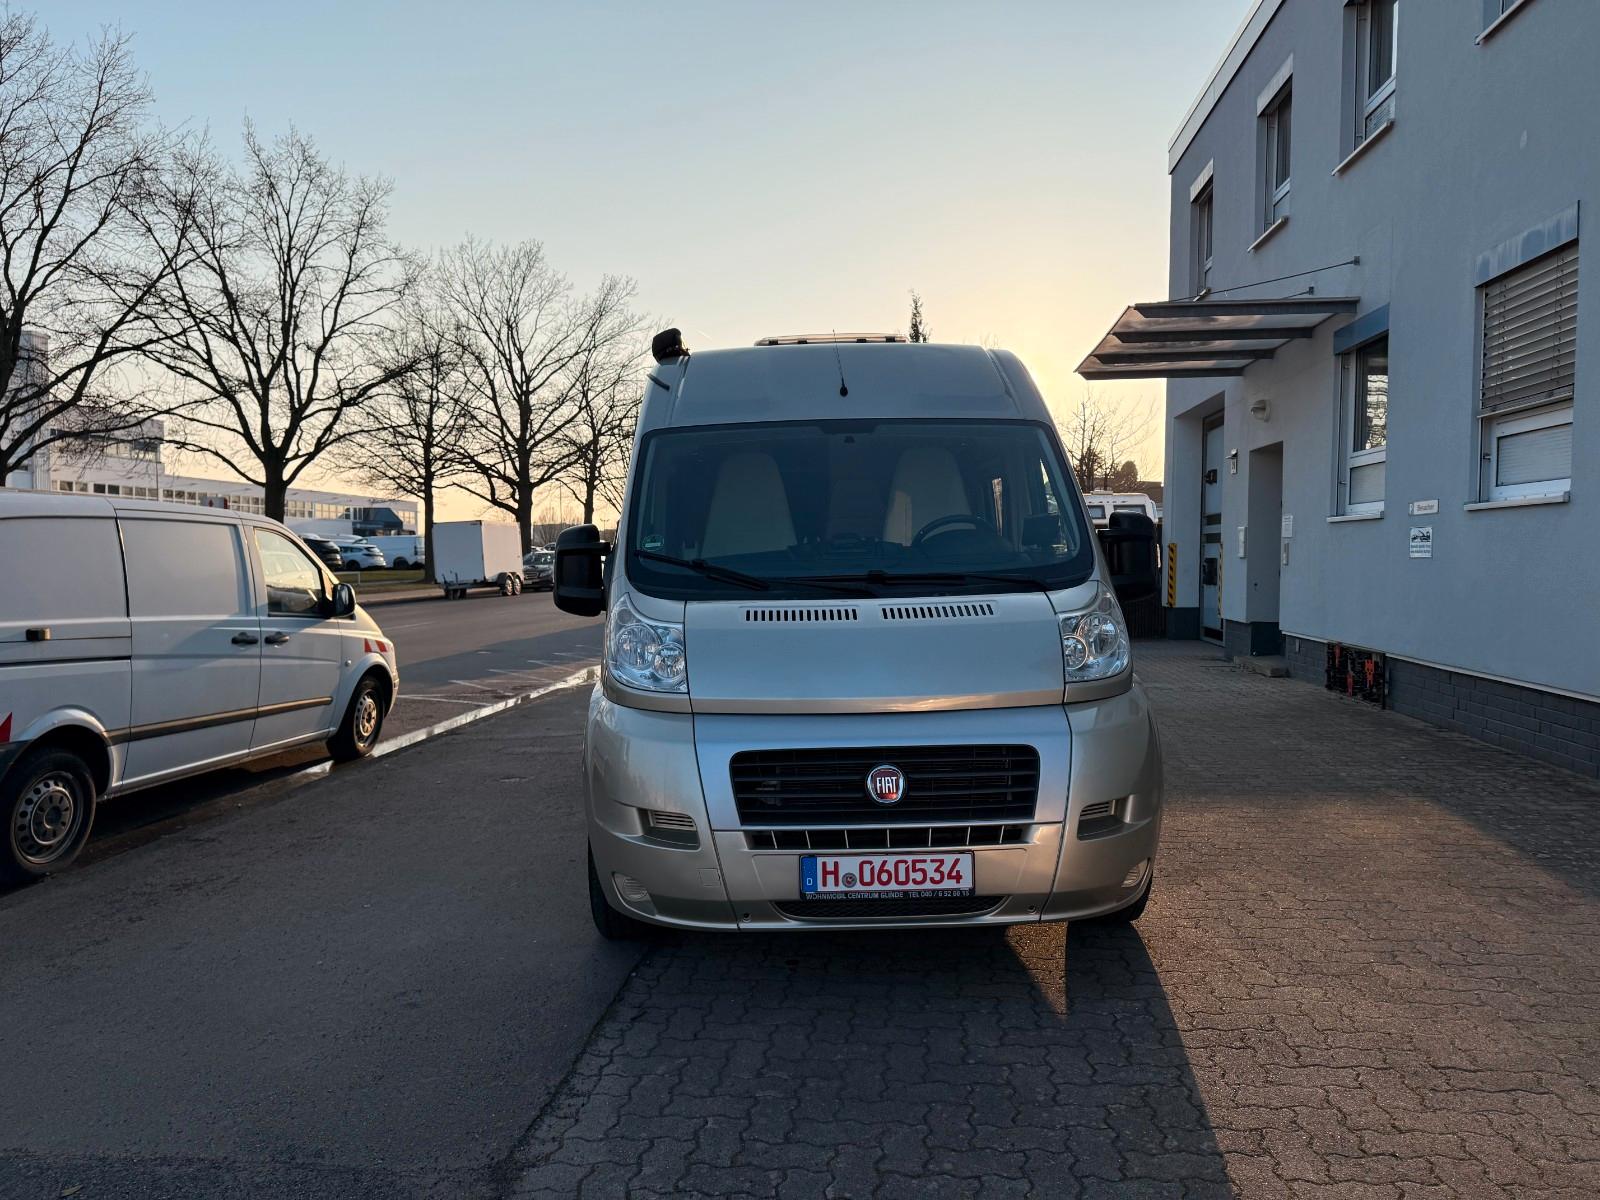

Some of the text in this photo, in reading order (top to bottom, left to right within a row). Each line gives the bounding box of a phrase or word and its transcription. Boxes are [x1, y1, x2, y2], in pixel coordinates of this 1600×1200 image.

[876, 776, 897, 794] FIAT
[821, 857, 963, 887] H 060534
[806, 877, 813, 886] D
